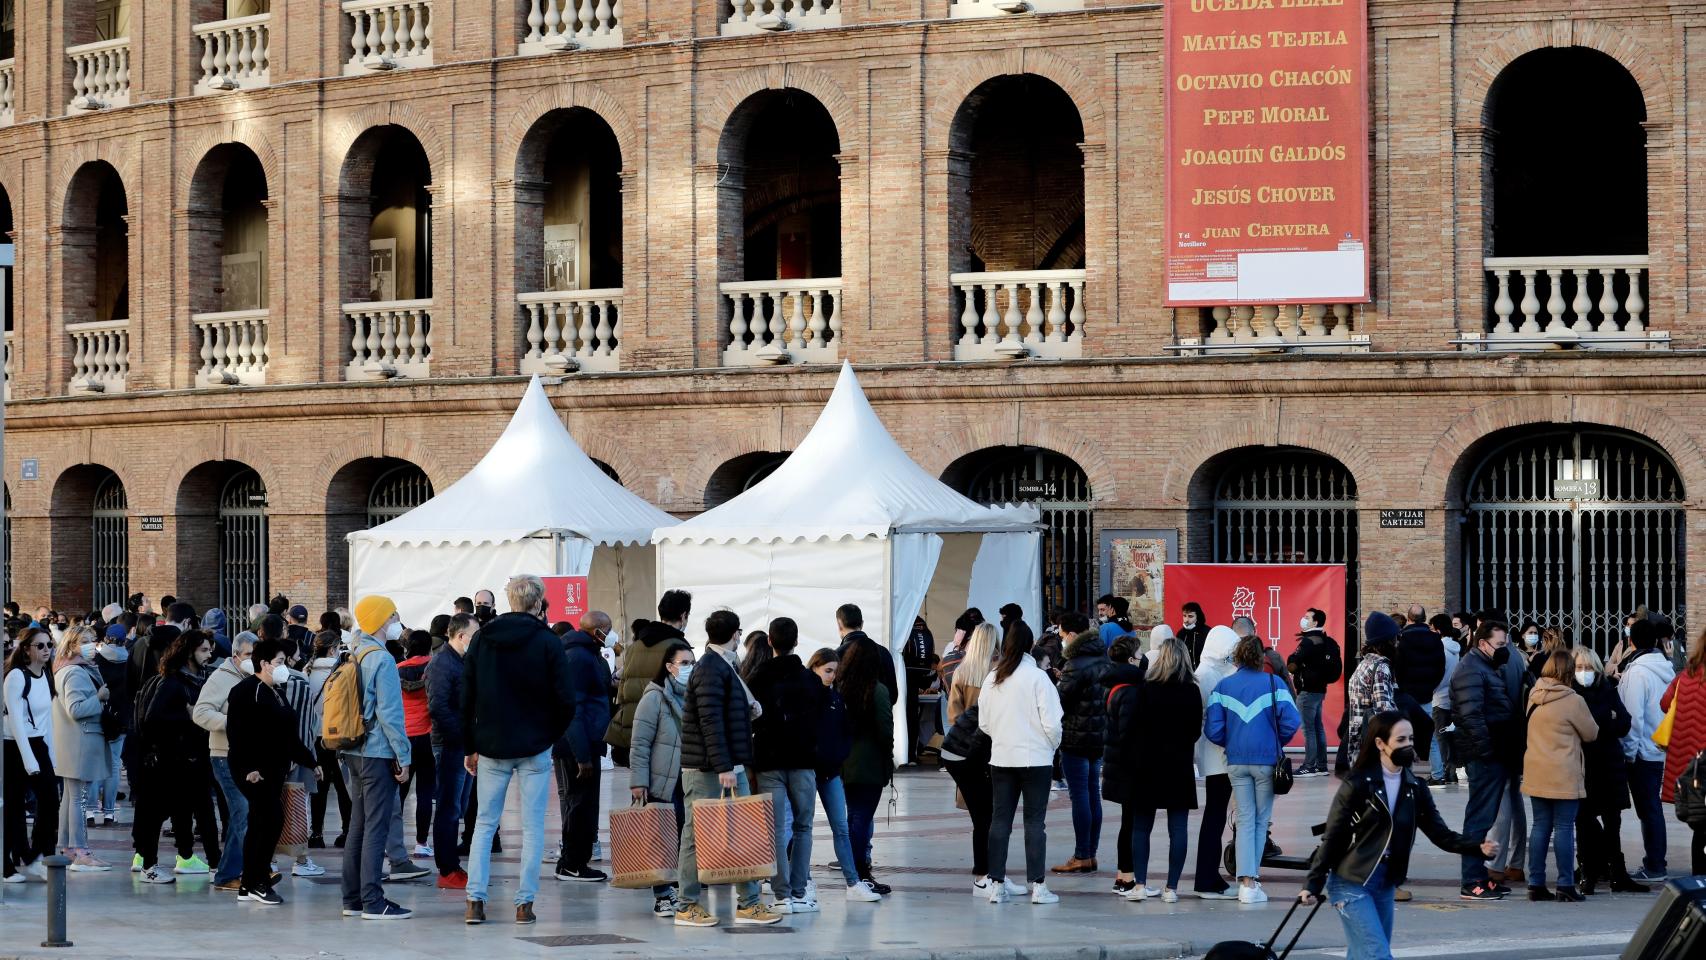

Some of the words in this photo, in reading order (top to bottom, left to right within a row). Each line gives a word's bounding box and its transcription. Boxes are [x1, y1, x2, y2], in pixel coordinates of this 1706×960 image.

[1182, 31, 1262, 52] MATÍAS
[1268, 30, 1349, 48] TEJELA
[1176, 73, 1263, 92] OCTAVIO
[1269, 65, 1352, 88] CHACÓN
[1203, 109, 1255, 126] PEPE
[1260, 106, 1330, 124] MORAL
[1181, 144, 1264, 166] JOAQUÍN
[1269, 141, 1346, 162] GALDÓS
[1191, 185, 1252, 206] JESÚS
[1257, 186, 1336, 204] CHOVER
[1202, 227, 1241, 239] JUAN
[1247, 223, 1330, 238] CERVERA
[1044, 482, 1057, 496] 14
[1584, 482, 1597, 495] 13
[1381, 518, 1424, 526] CARTELES
[710, 868, 758, 879] PRIMARK
